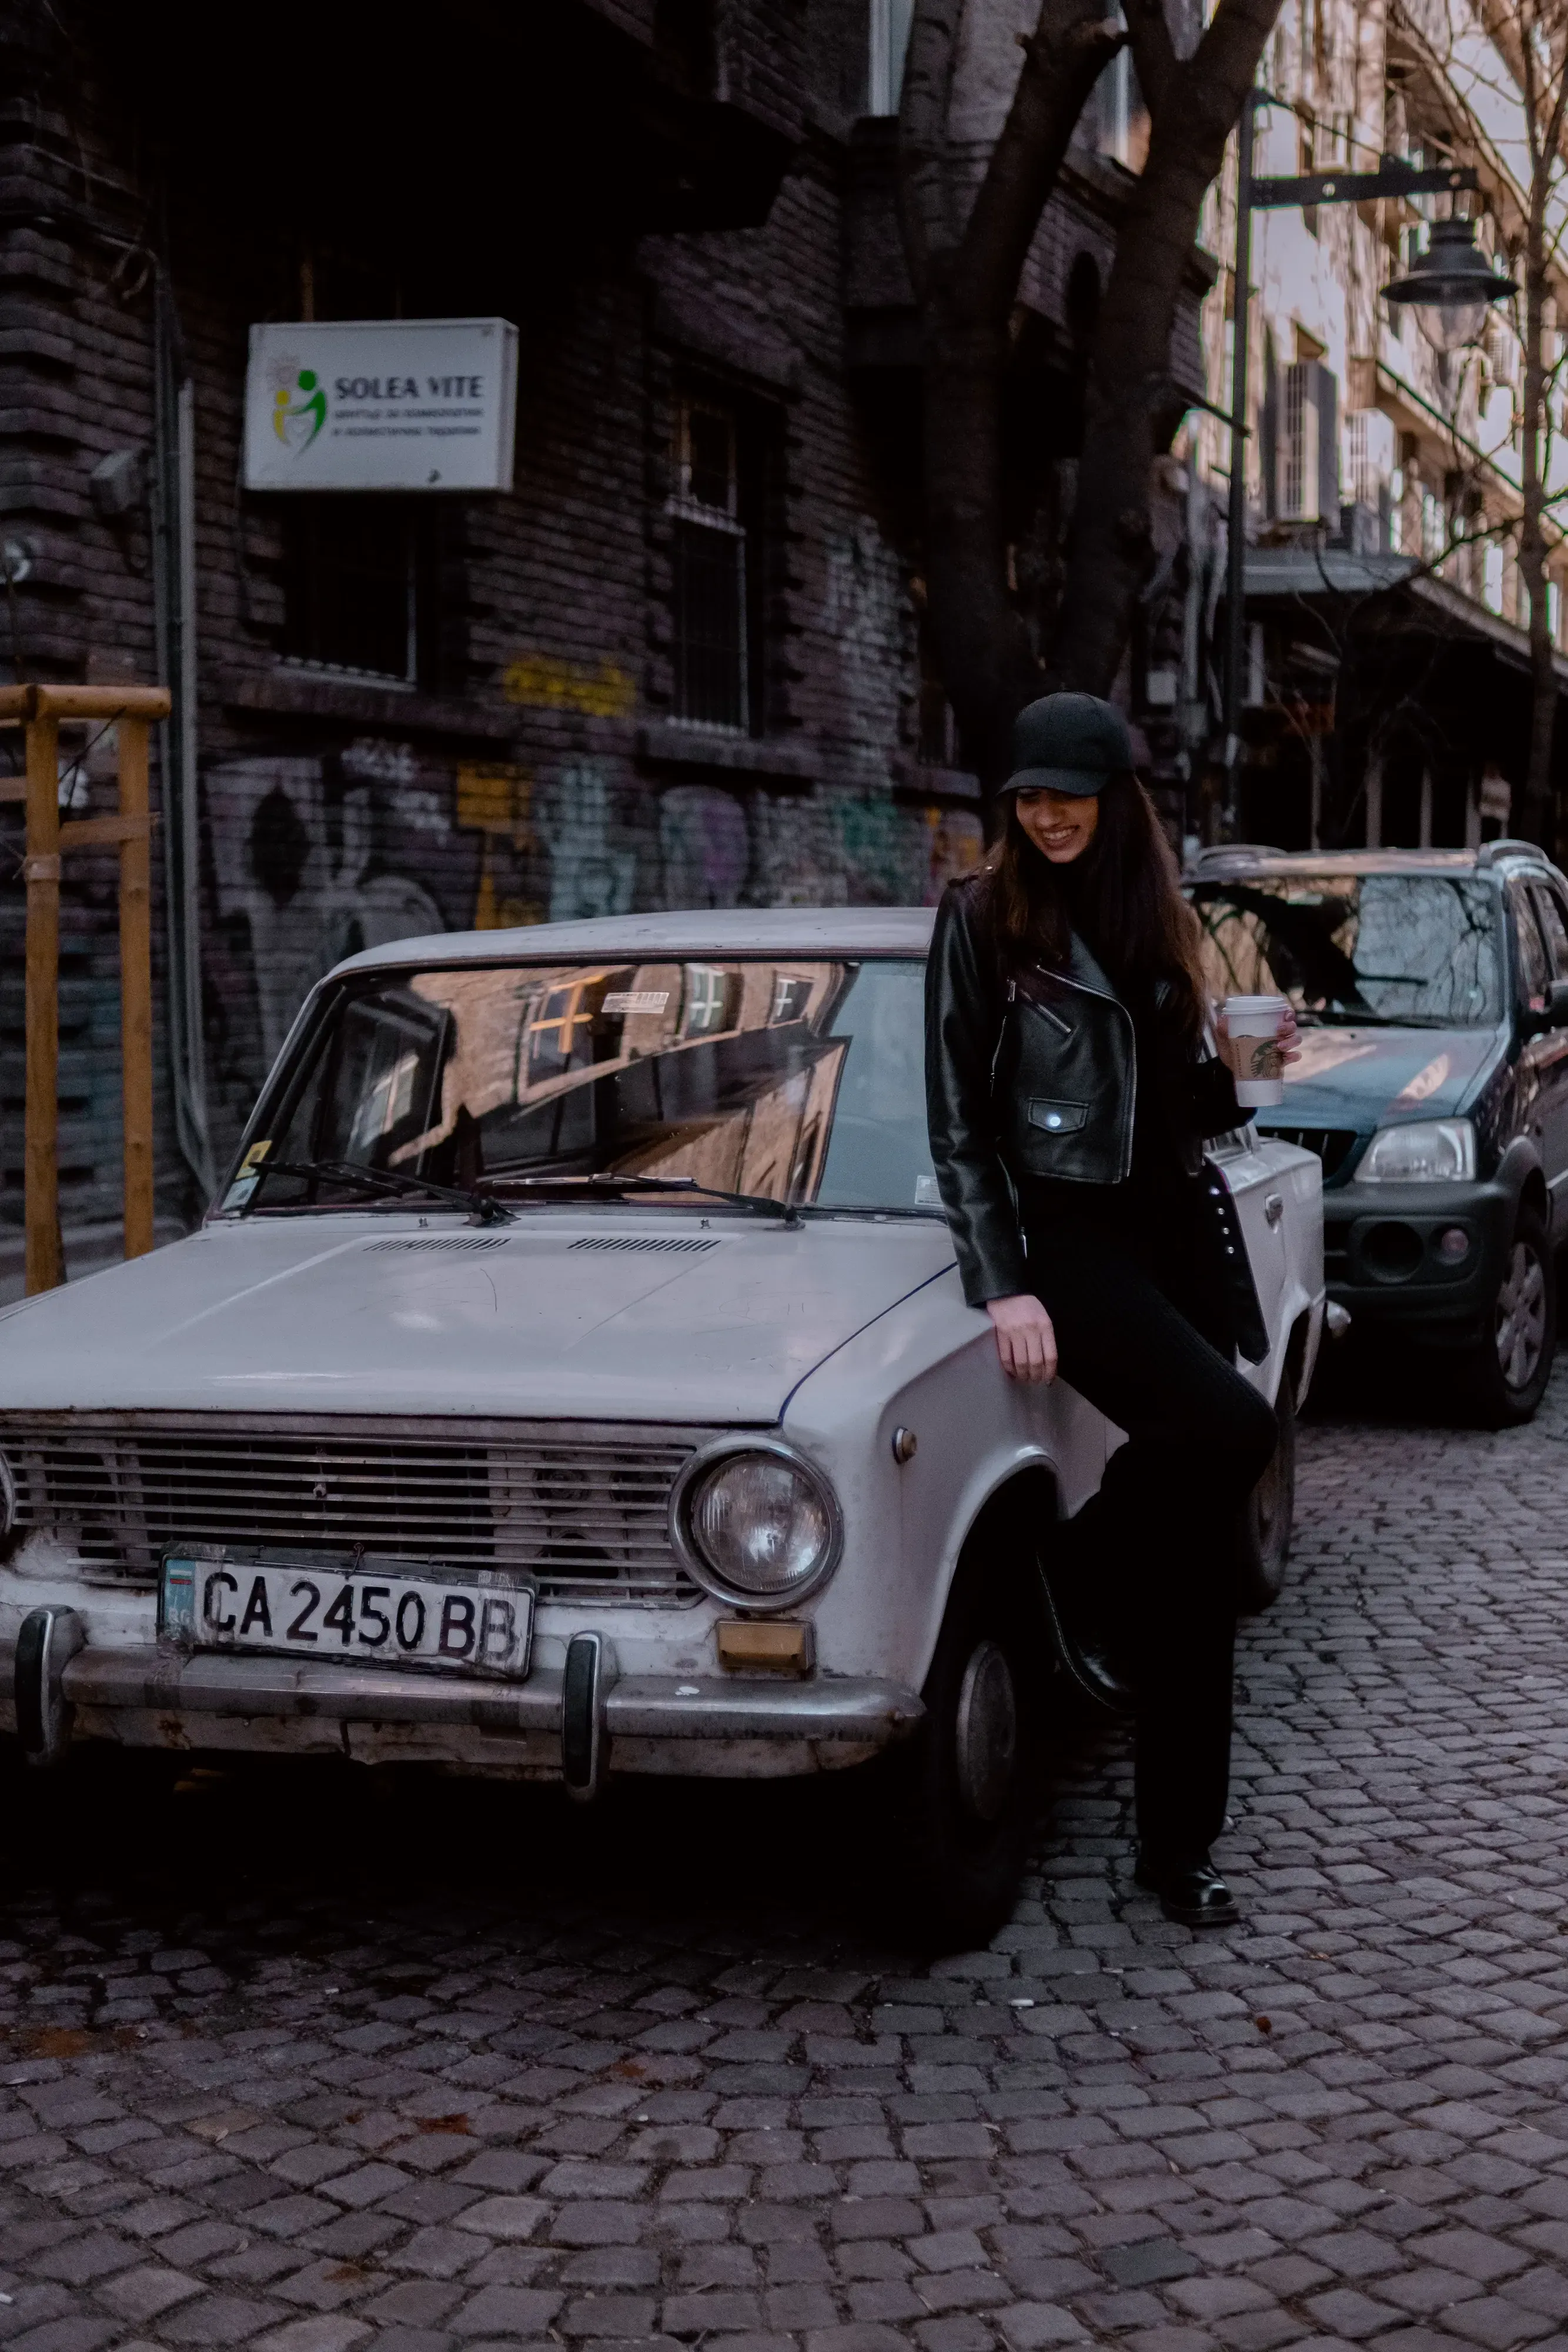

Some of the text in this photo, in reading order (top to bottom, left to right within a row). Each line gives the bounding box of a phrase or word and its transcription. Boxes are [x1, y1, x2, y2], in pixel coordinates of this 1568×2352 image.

[336, 375, 483, 399] SOLEA VITE
[204, 1572, 516, 1662] CA 2450 BB
